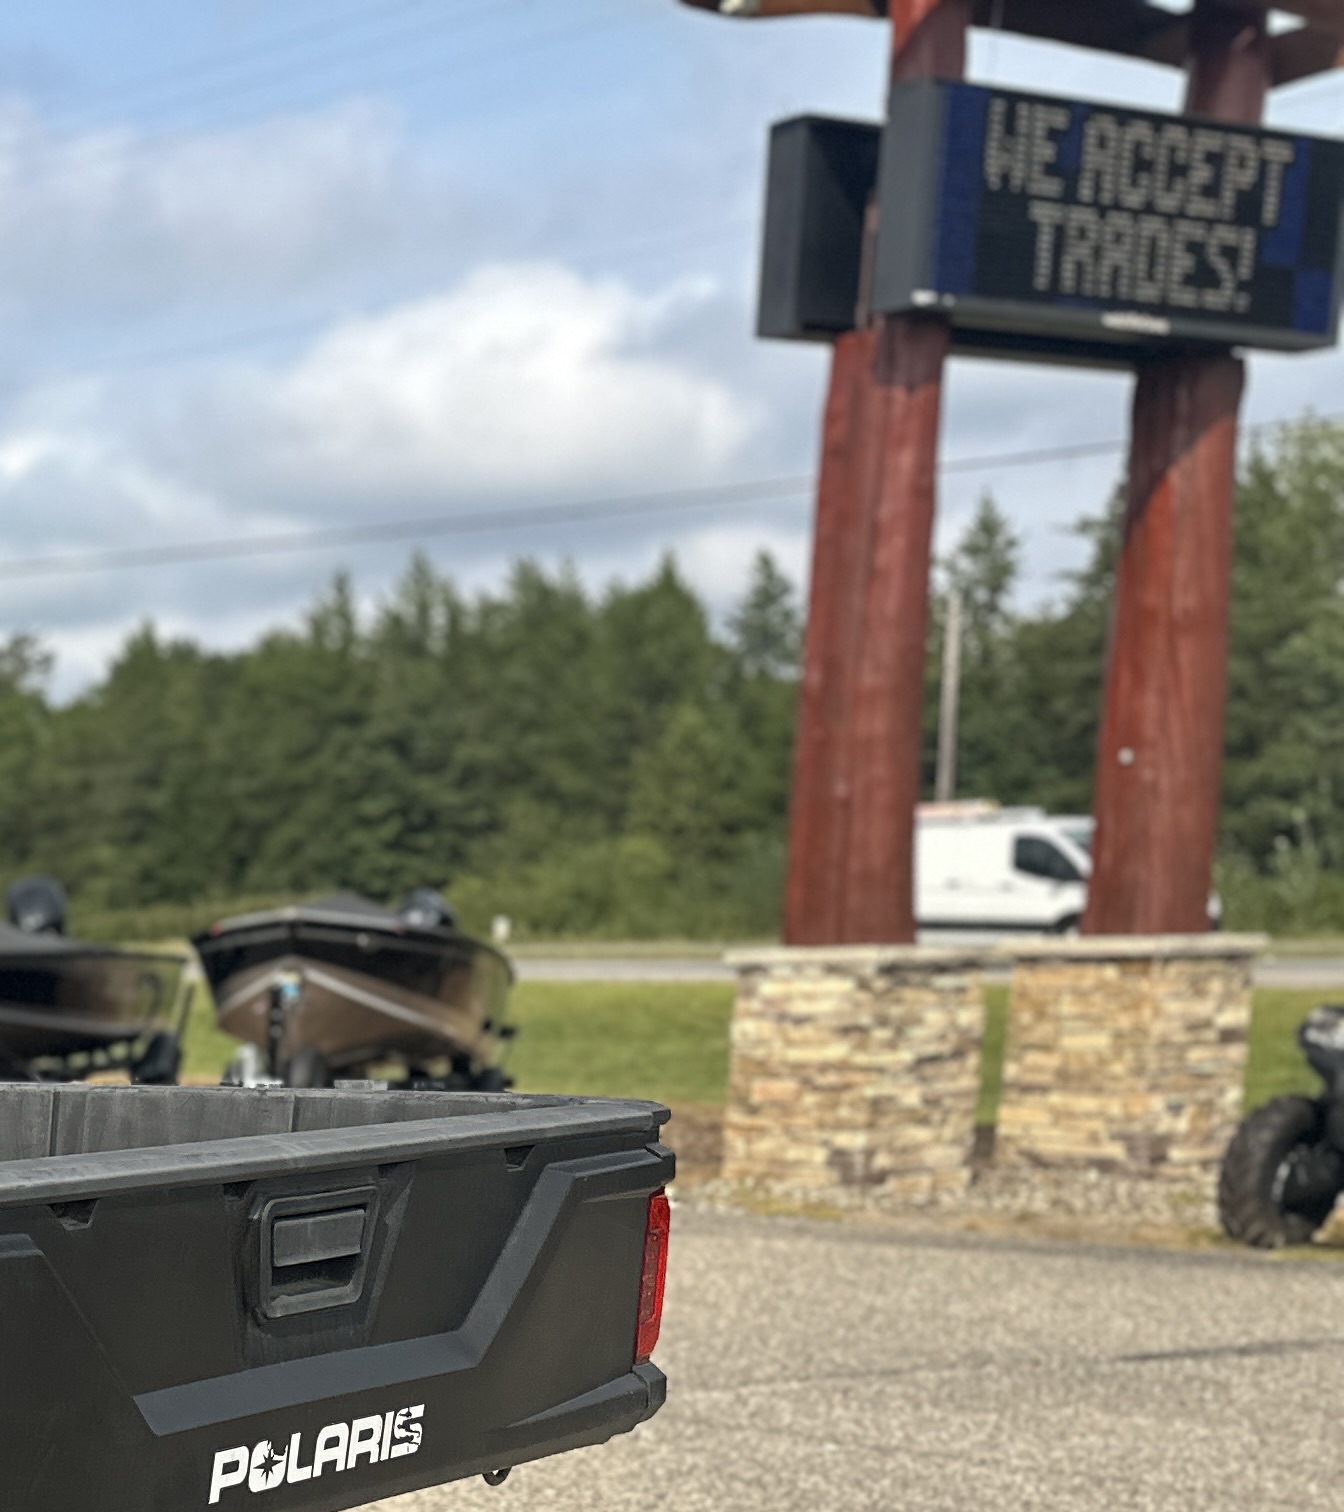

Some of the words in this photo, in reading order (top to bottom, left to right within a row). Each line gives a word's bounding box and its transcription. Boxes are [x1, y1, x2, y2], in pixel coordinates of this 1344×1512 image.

[984, 97, 1072, 199] WE
[1076, 112, 1295, 228] ACCEPT
[1027, 198, 1257, 314] TRADES!
[208, 1404, 425, 1504] POLARIS
